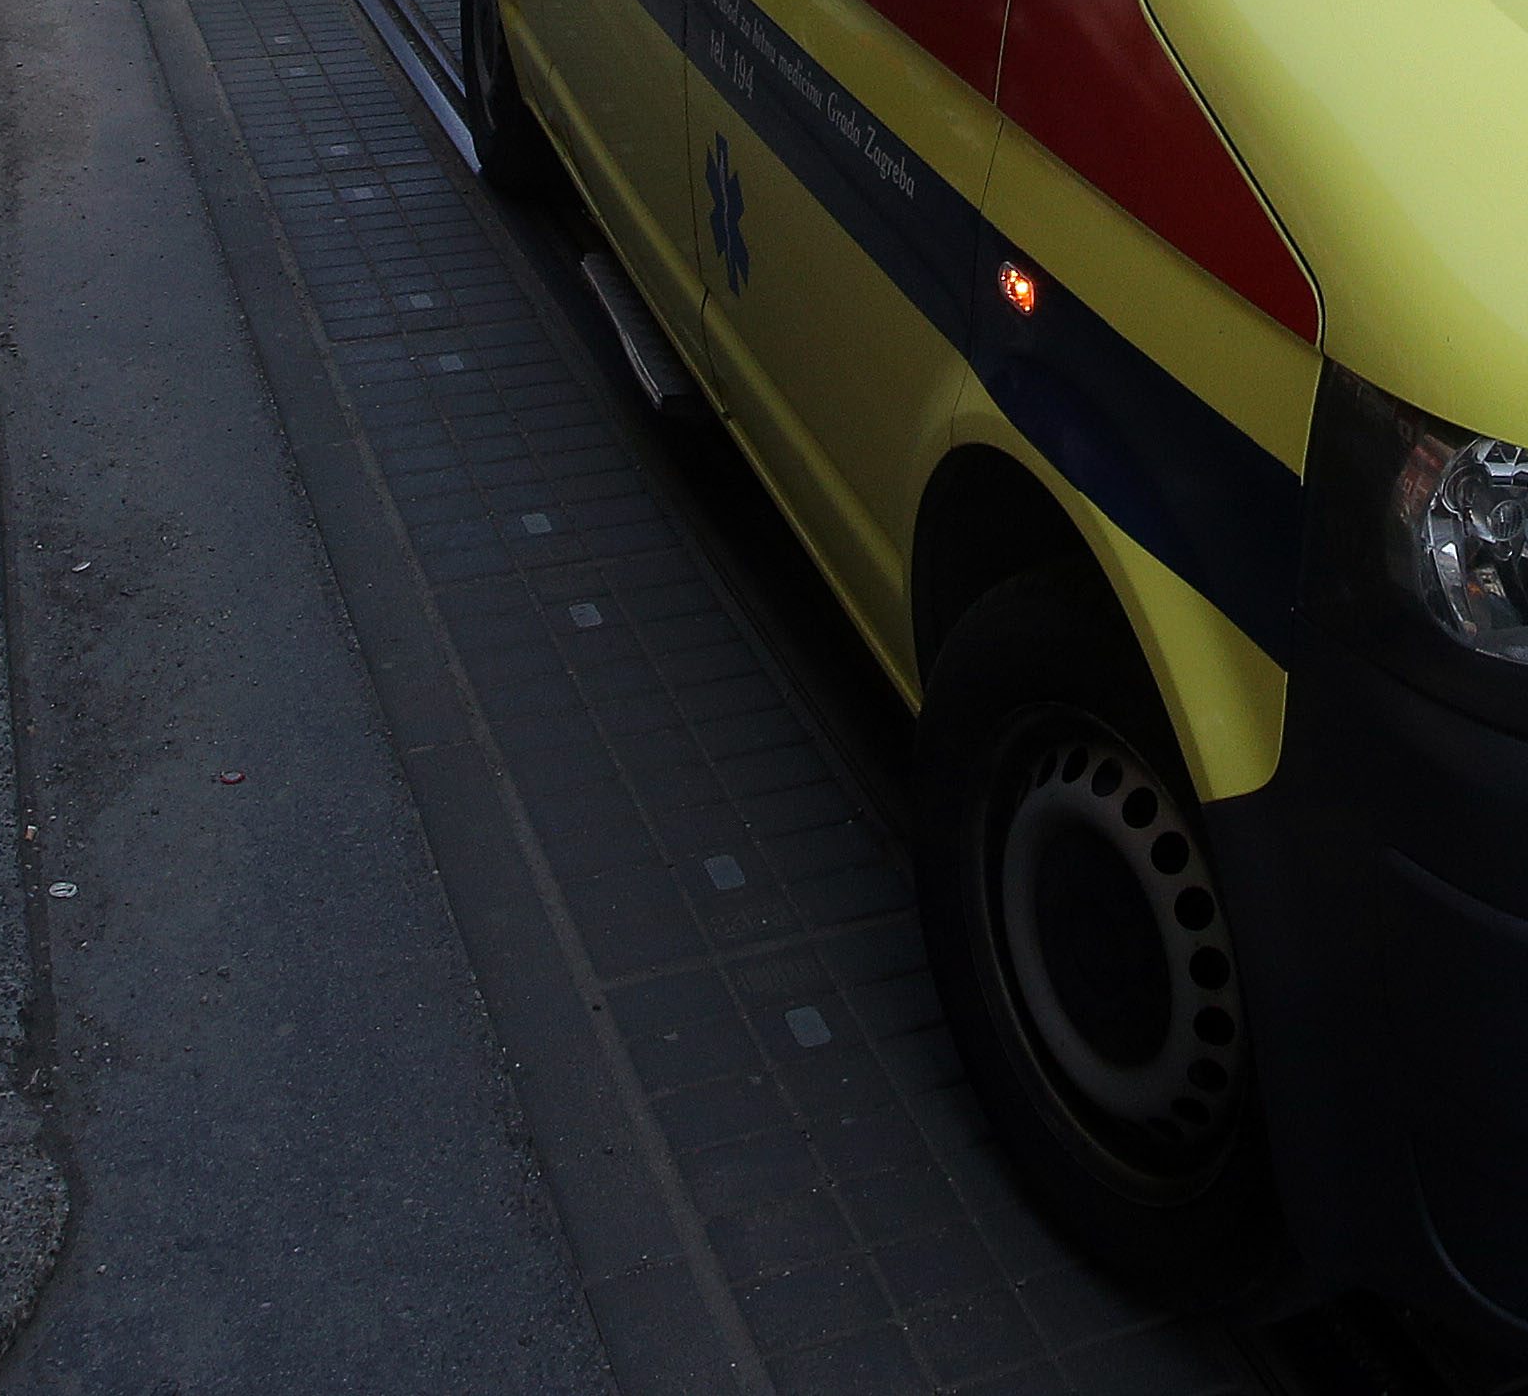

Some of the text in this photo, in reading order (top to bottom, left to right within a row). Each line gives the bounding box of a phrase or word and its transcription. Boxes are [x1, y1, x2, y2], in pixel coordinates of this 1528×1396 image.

[733, 49, 754, 101] 194
[778, 54, 824, 111] medicinu
[827, 92, 861, 149] Grada
[863, 125, 915, 200] Zagreba
